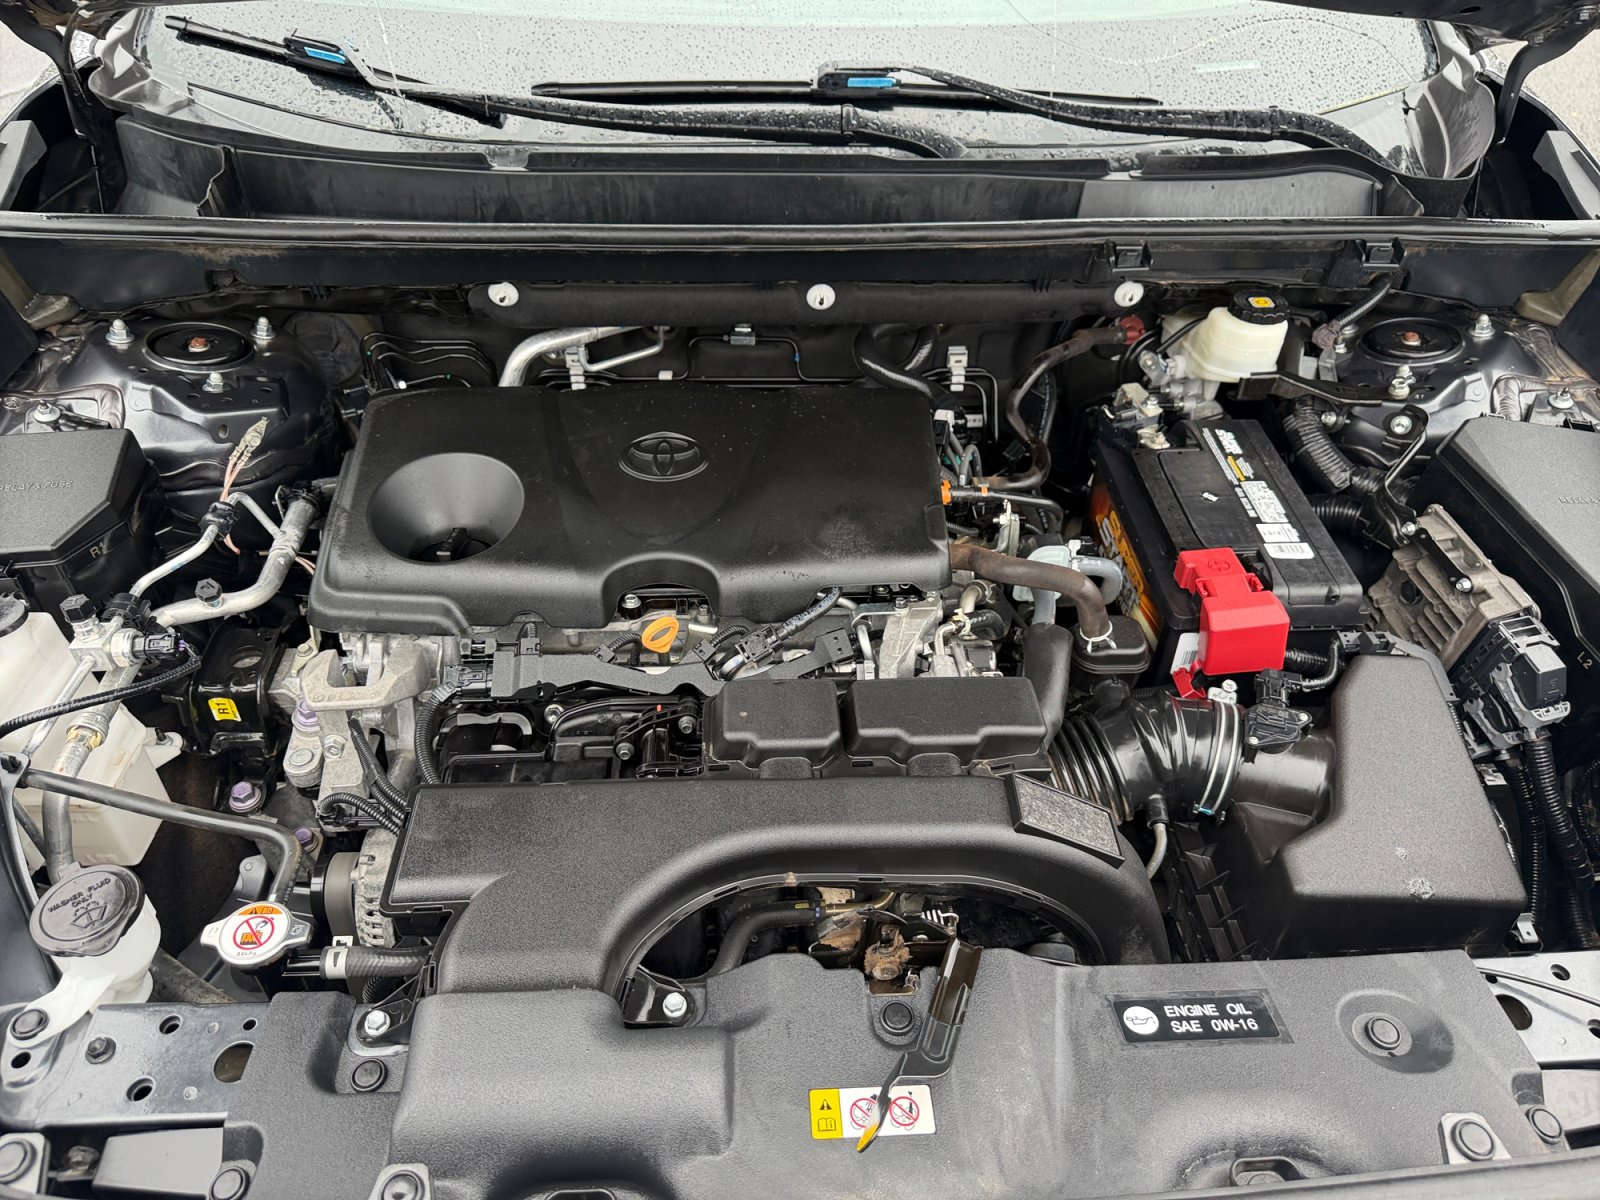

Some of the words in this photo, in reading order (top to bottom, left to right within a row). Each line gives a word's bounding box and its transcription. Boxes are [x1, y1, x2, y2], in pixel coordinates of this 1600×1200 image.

[44, 480, 73, 489] FUSE
[89, 541, 107, 559] R1
[1107, 510, 1144, 597] SUPER
[1577, 651, 1593, 670] L2
[215, 702, 230, 715] R1
[47, 891, 84, 913] WASHER
[87, 878, 111, 892] FLUID
[71, 893, 93, 908] ONLY
[1163, 1004, 1219, 1018] ENGINE
[1226, 1003, 1252, 1015] OIL
[1170, 1020, 1203, 1033] SAE
[1211, 1018, 1259, 1031] 0W-16
